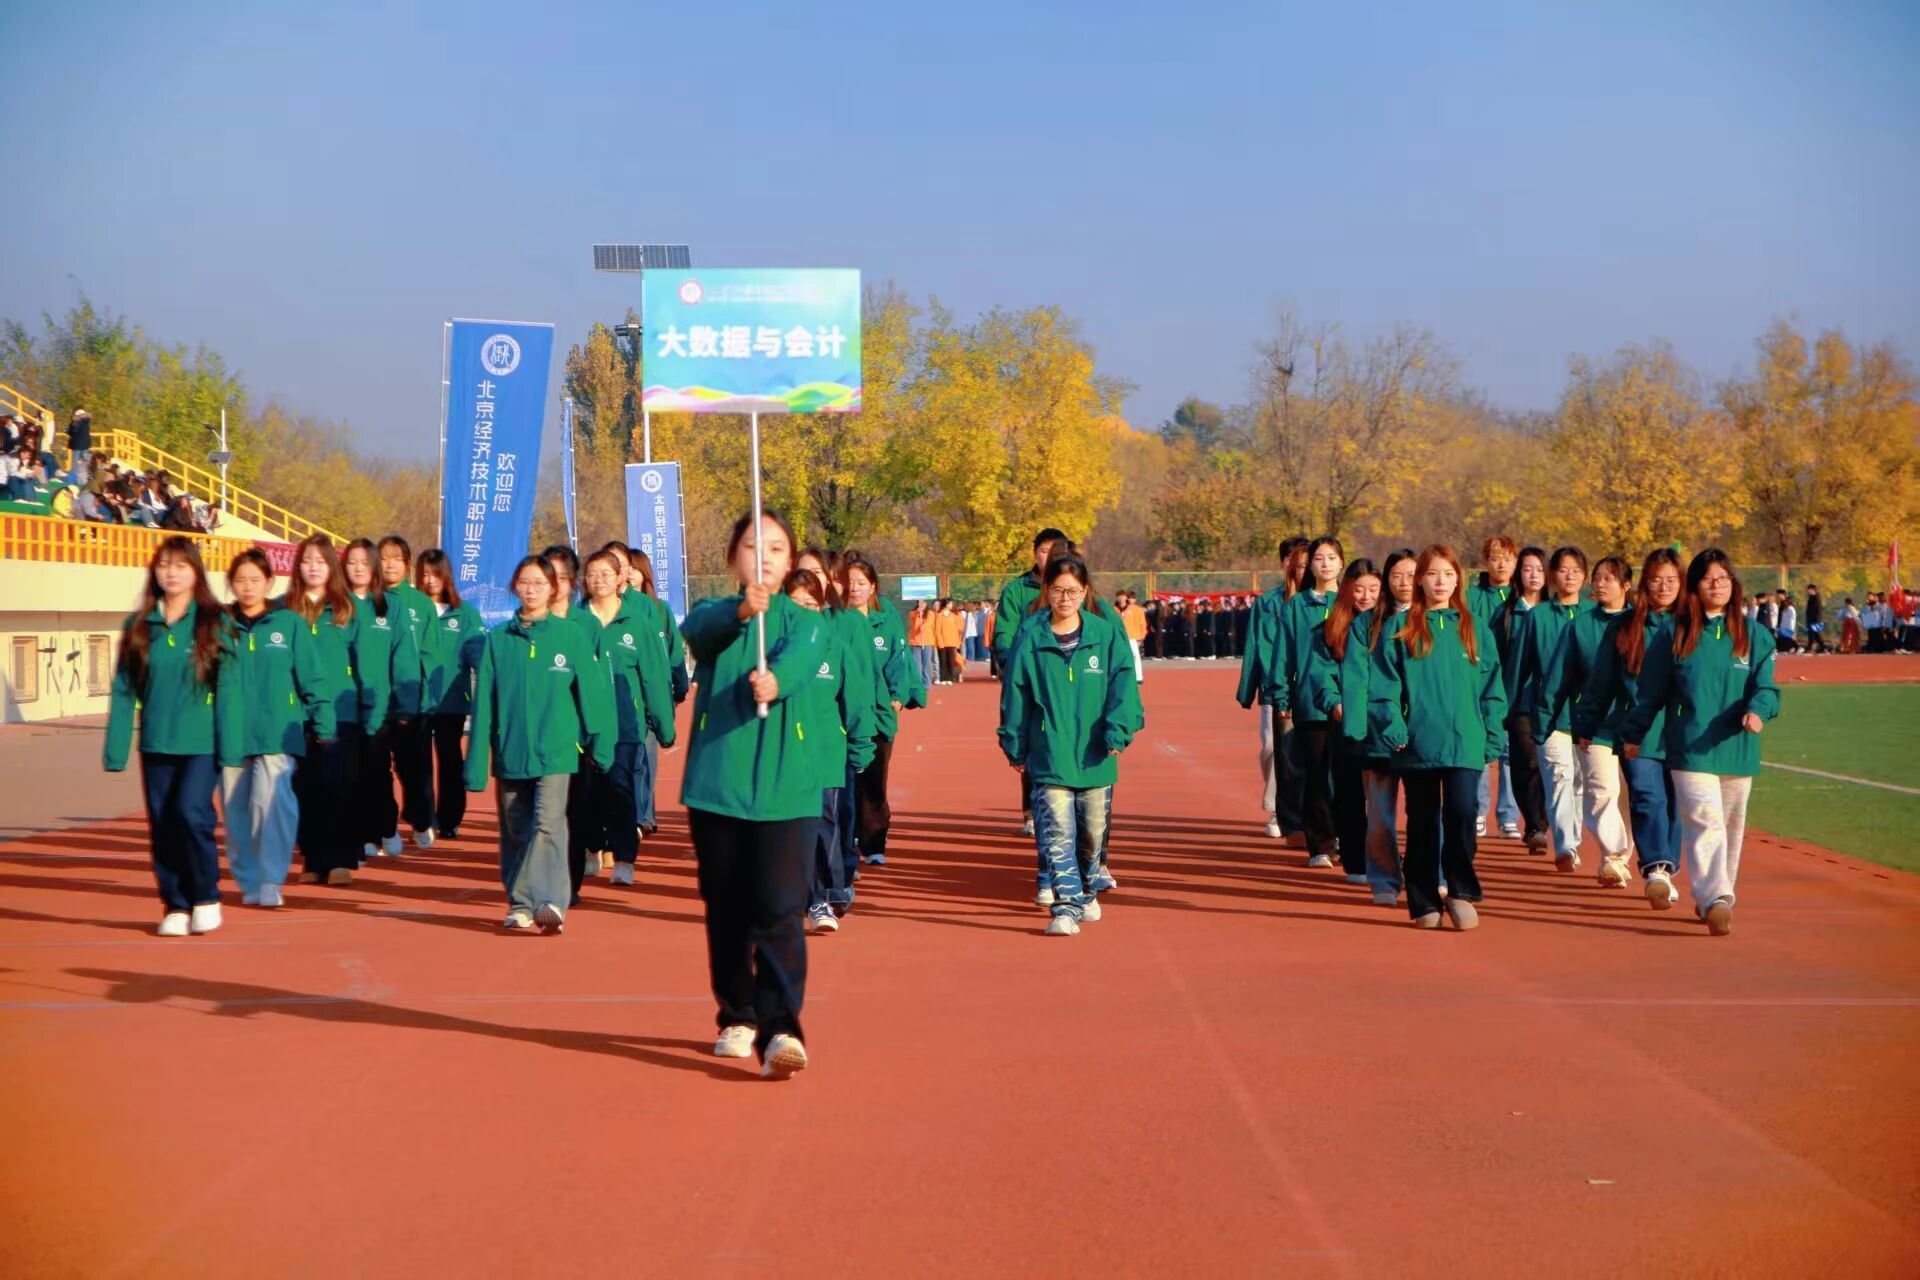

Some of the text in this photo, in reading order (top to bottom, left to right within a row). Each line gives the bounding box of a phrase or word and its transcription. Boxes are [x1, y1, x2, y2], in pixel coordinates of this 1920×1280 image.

[658, 325, 846, 358] 大数据与会计
[461, 380, 496, 581] 北京经济技术职业学院
[492, 453, 516, 512] 欢迎您
